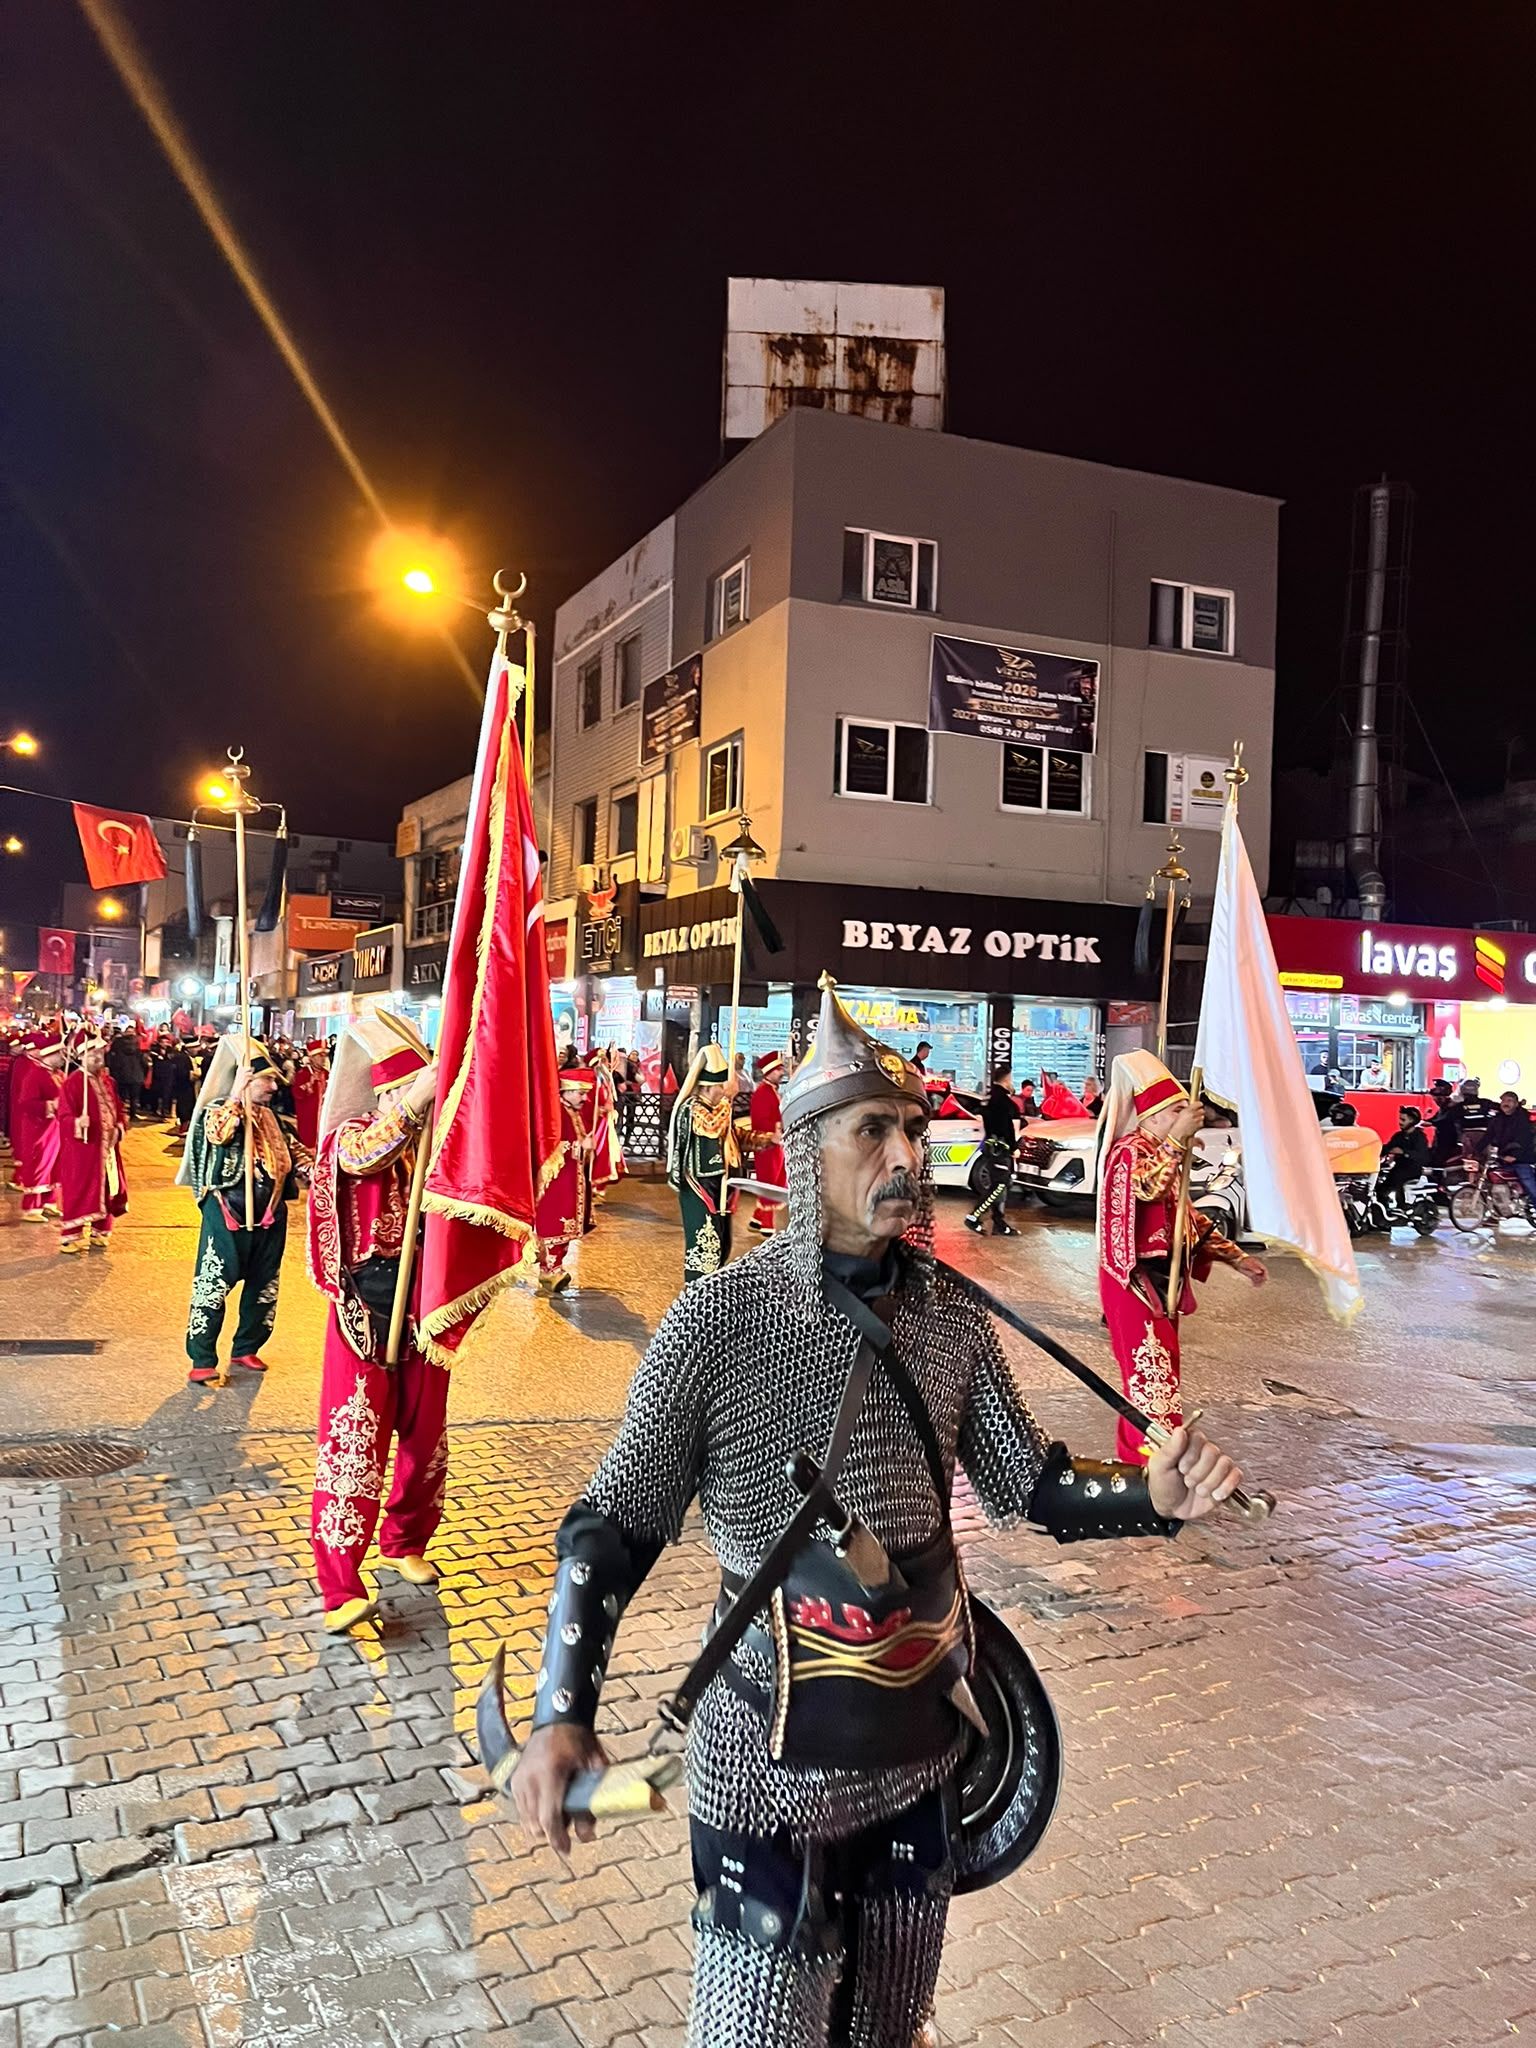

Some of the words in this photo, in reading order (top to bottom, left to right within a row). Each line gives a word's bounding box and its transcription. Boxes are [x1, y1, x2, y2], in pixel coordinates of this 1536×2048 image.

[1004, 682, 1039, 698] 2026
[643, 926, 689, 958] BEYAZ
[842, 920, 972, 955] BEYAZ
[1361, 930, 1458, 982] lavaş
[1382, 1012, 1419, 1026] center
